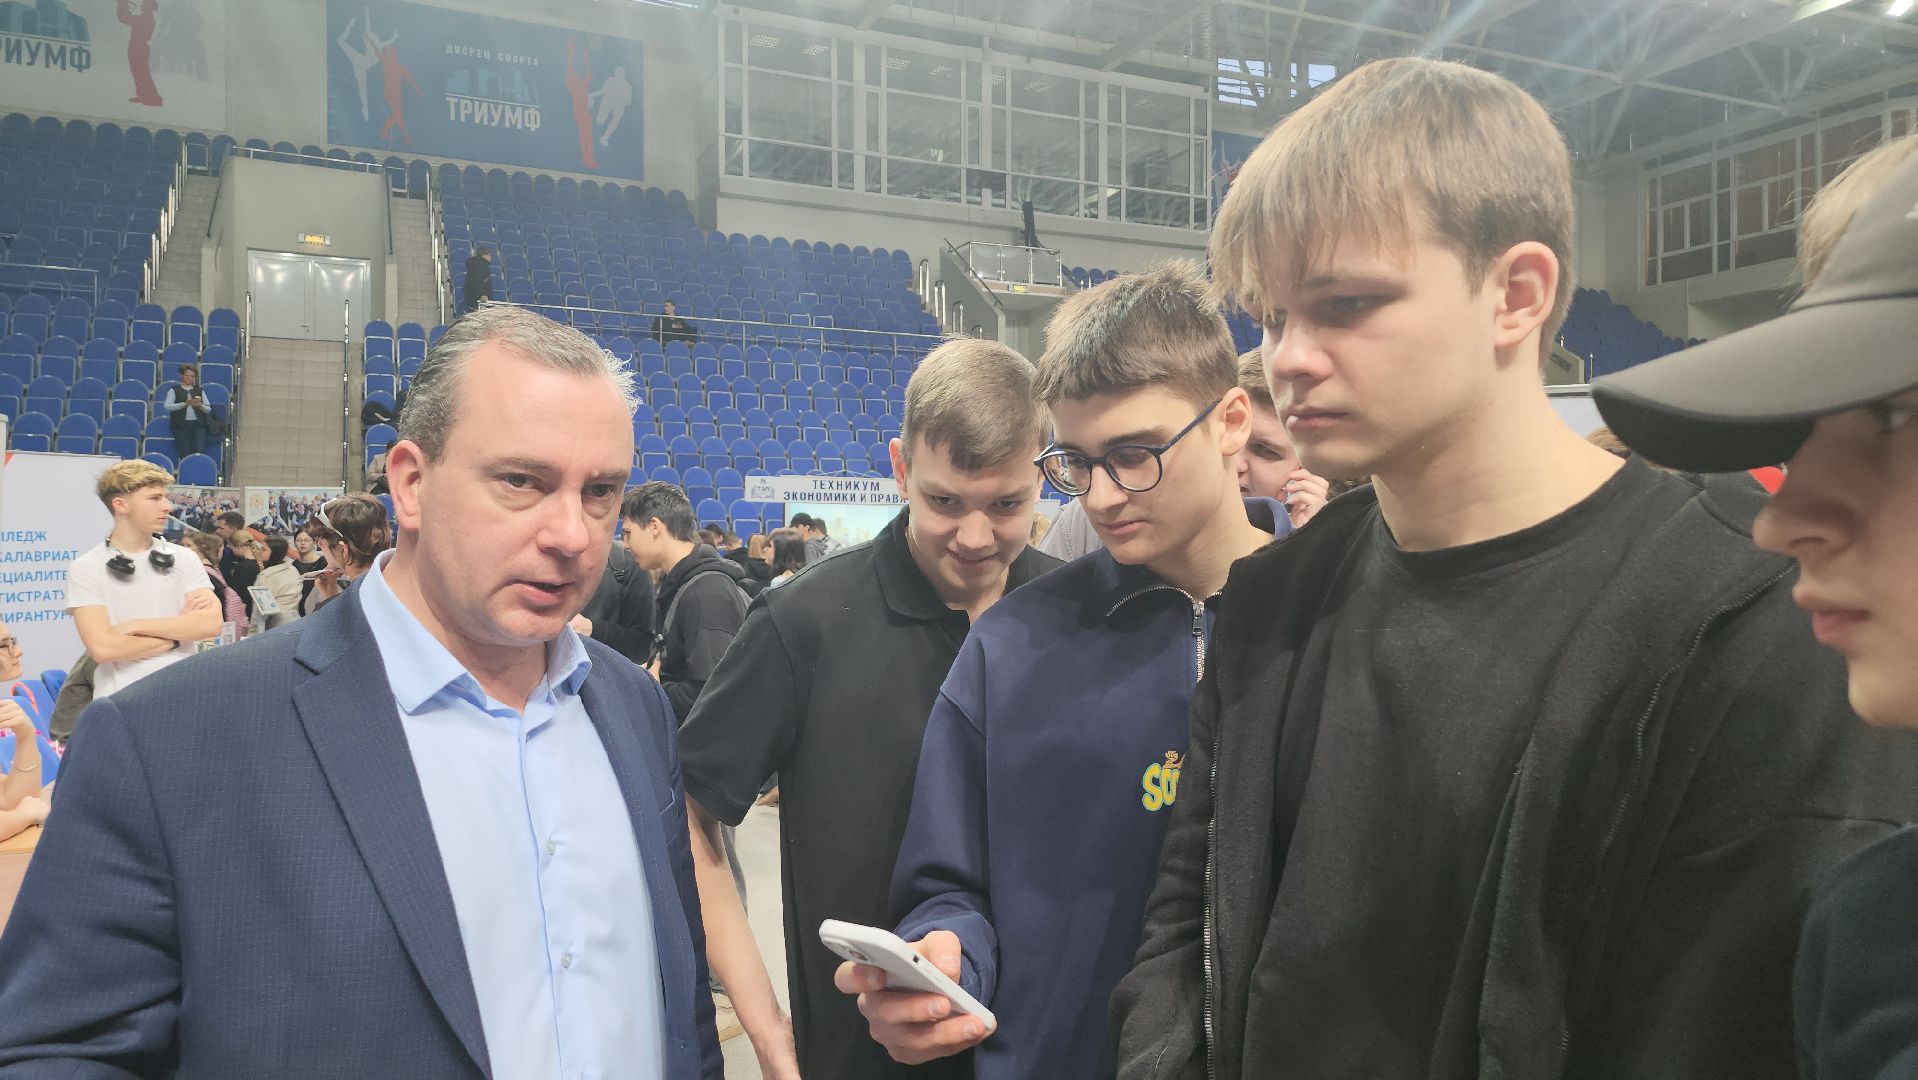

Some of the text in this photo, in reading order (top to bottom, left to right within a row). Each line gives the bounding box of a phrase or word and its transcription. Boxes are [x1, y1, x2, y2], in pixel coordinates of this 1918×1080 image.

[0, 36, 91, 72] ИУМФ
[446, 44, 539, 66] ДВОРЕЦ СПОРТА
[446, 97, 540, 132] ТРИУМФ
[812, 479, 880, 491] ТЕХНИКУМ
[783, 491, 856, 503] ЭКОНОМИКИ
[860, 493, 867, 503] И
[0, 570, 67, 584] ЦИАЛИТЕ
